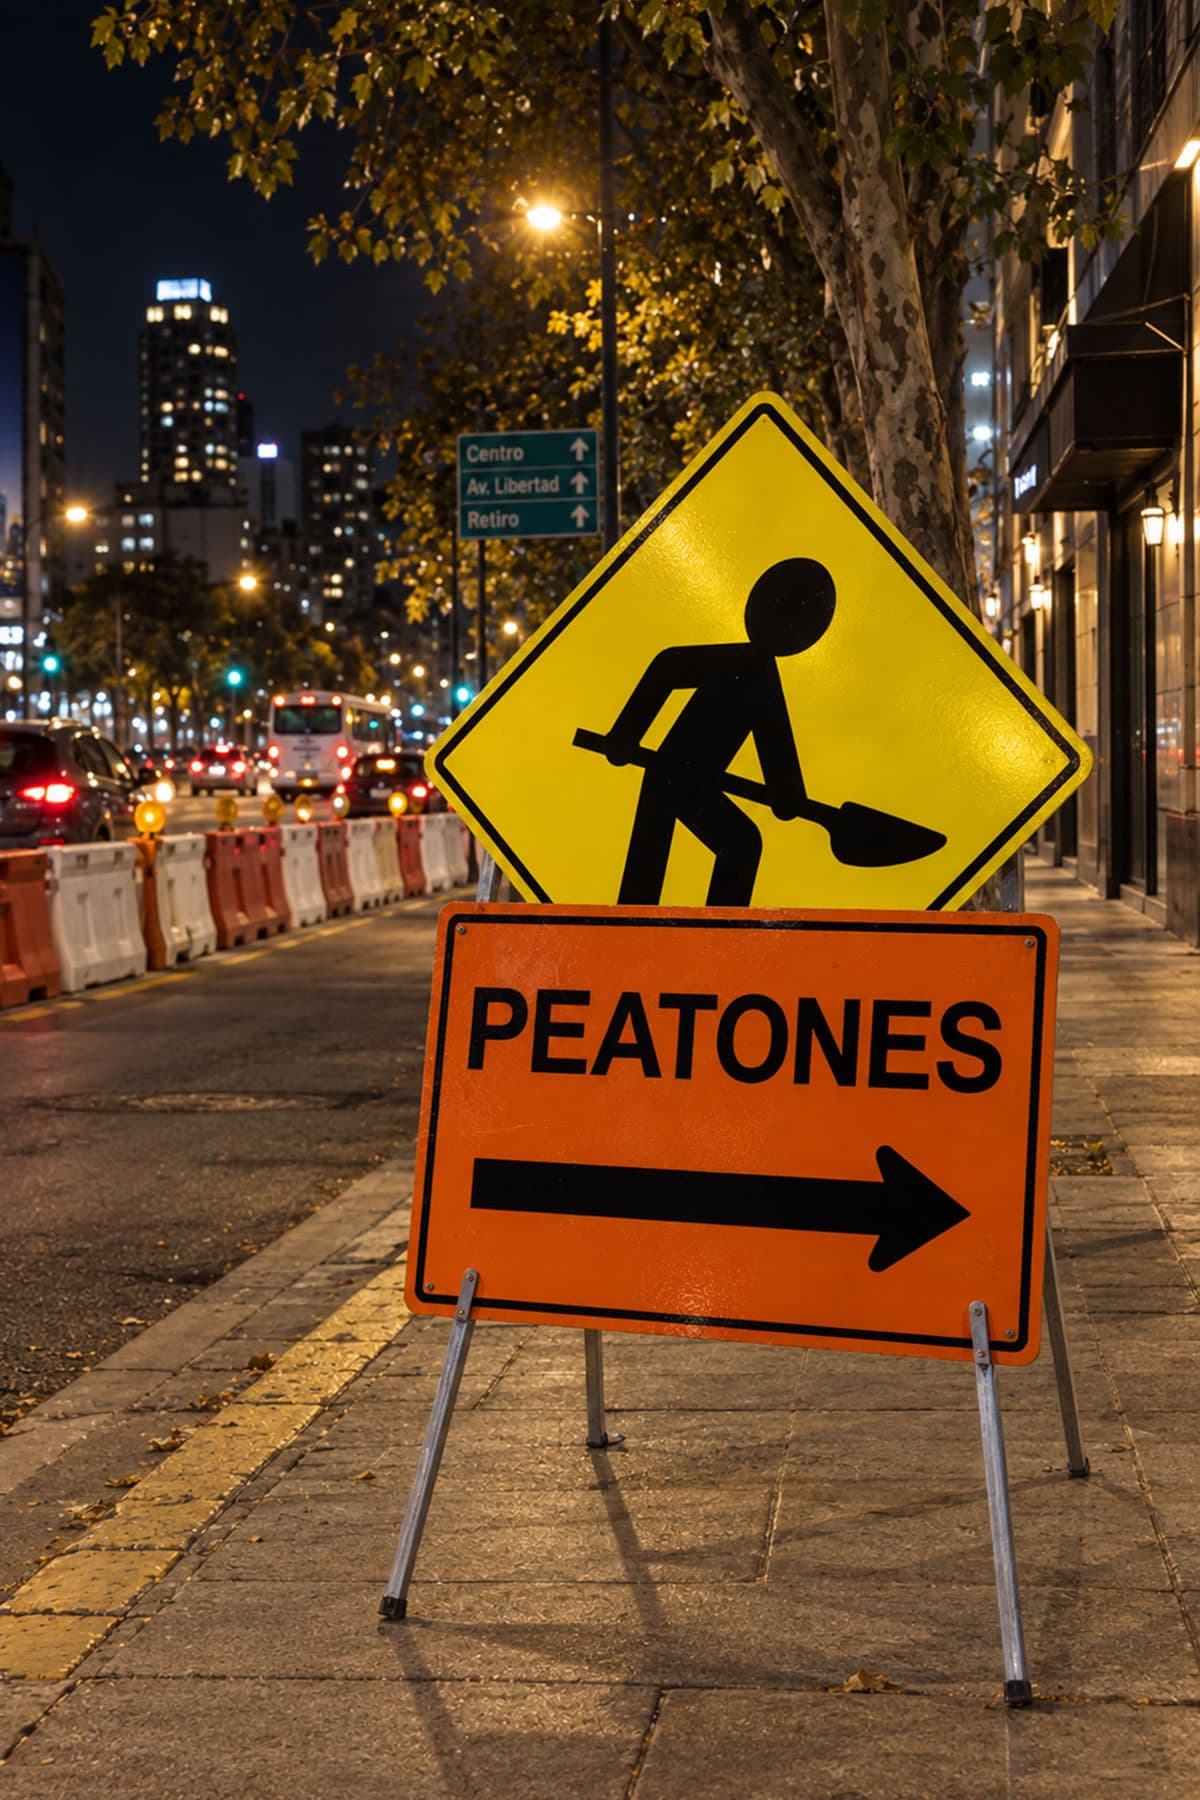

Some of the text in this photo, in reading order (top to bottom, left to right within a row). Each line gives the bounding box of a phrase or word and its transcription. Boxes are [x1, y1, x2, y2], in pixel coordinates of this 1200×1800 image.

[466, 444, 524, 463] Centro
[466, 475, 560, 495] Av. Libertad
[467, 510, 519, 529] Retiro
[467, 986, 1003, 1094] PEATONES
